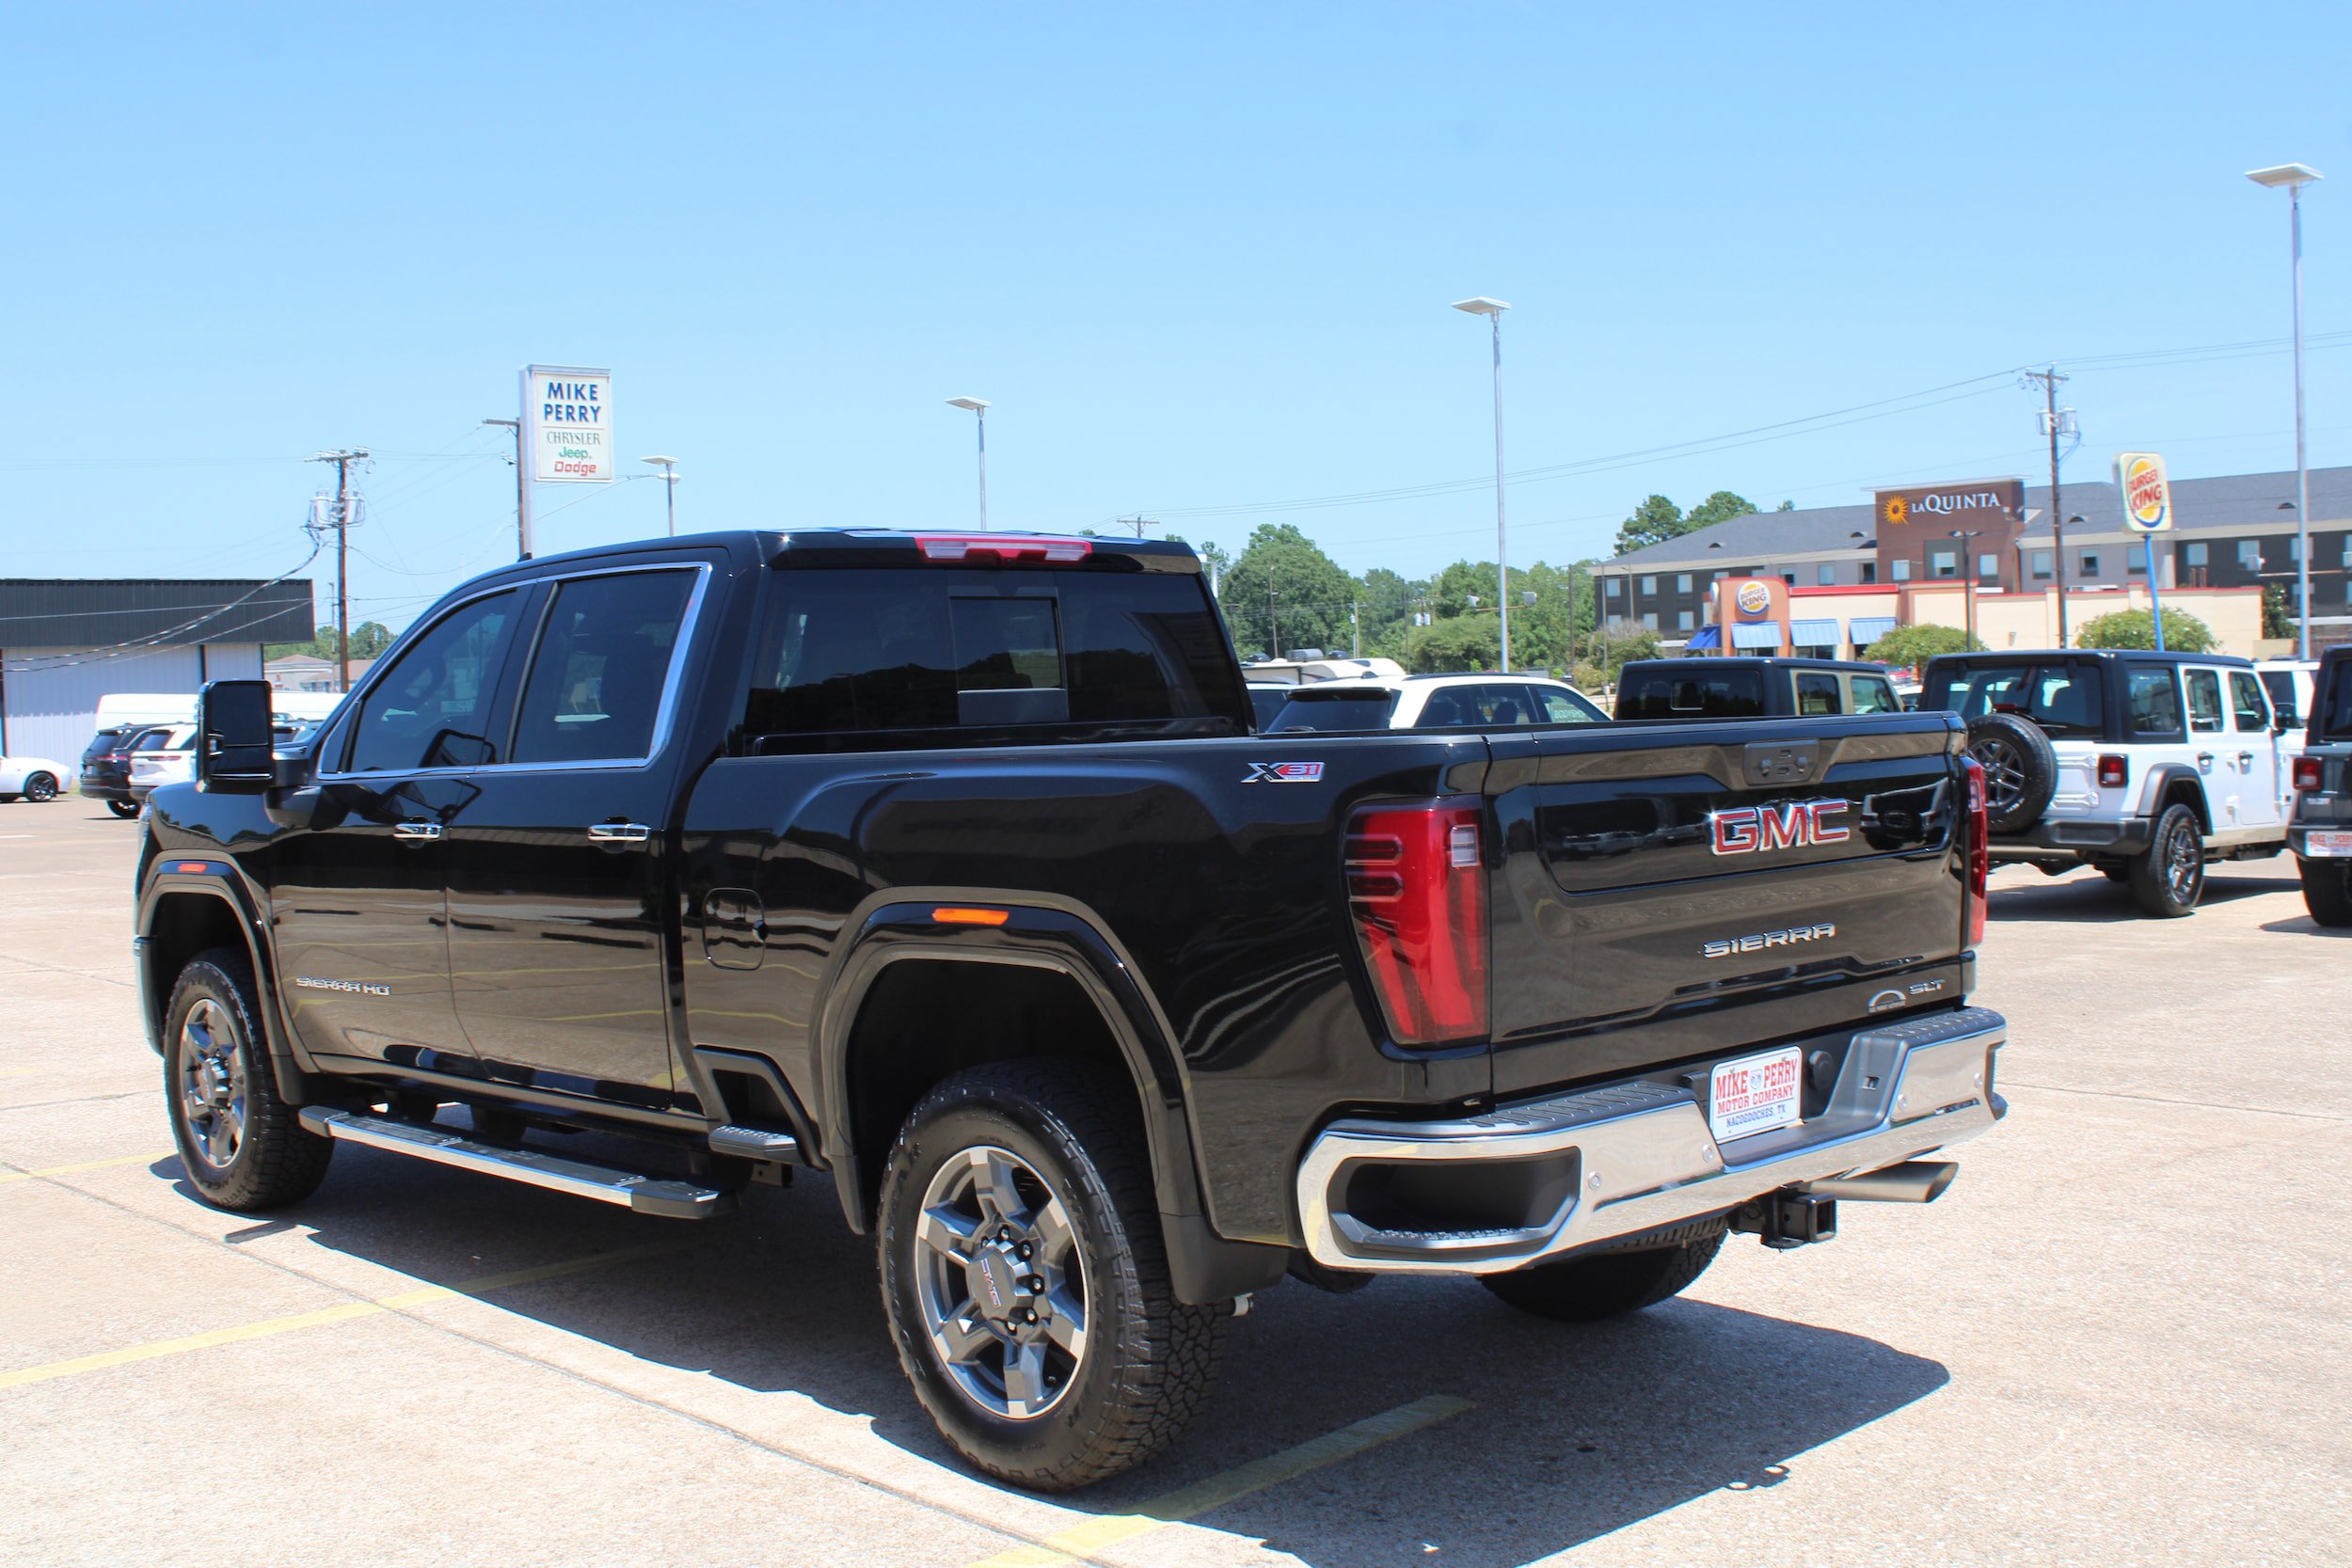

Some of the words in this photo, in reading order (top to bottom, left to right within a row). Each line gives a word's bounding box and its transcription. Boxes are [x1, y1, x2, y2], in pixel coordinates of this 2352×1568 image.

[548, 382, 598, 402] MIKE
[544, 404, 601, 423] PERRY
[547, 431, 600, 446] CHRYSLER
[554, 461, 596, 477] Dodge
[2129, 467, 2159, 495] BURGER
[2132, 483, 2162, 510] KING
[1741, 593, 1767, 608] KING
[1710, 798, 1850, 856] GMC
[1704, 923, 1836, 958] SIERRA
[296, 976, 361, 992] SIERRA
[362, 984, 390, 996] HD
[1909, 979, 1946, 994] SLT
[1715, 1070, 1748, 1101] MIKE
[1764, 1059, 1797, 1088] PERRY
[1717, 1096, 1750, 1115] MOTOR
[1753, 1085, 1794, 1105] COMPANY
